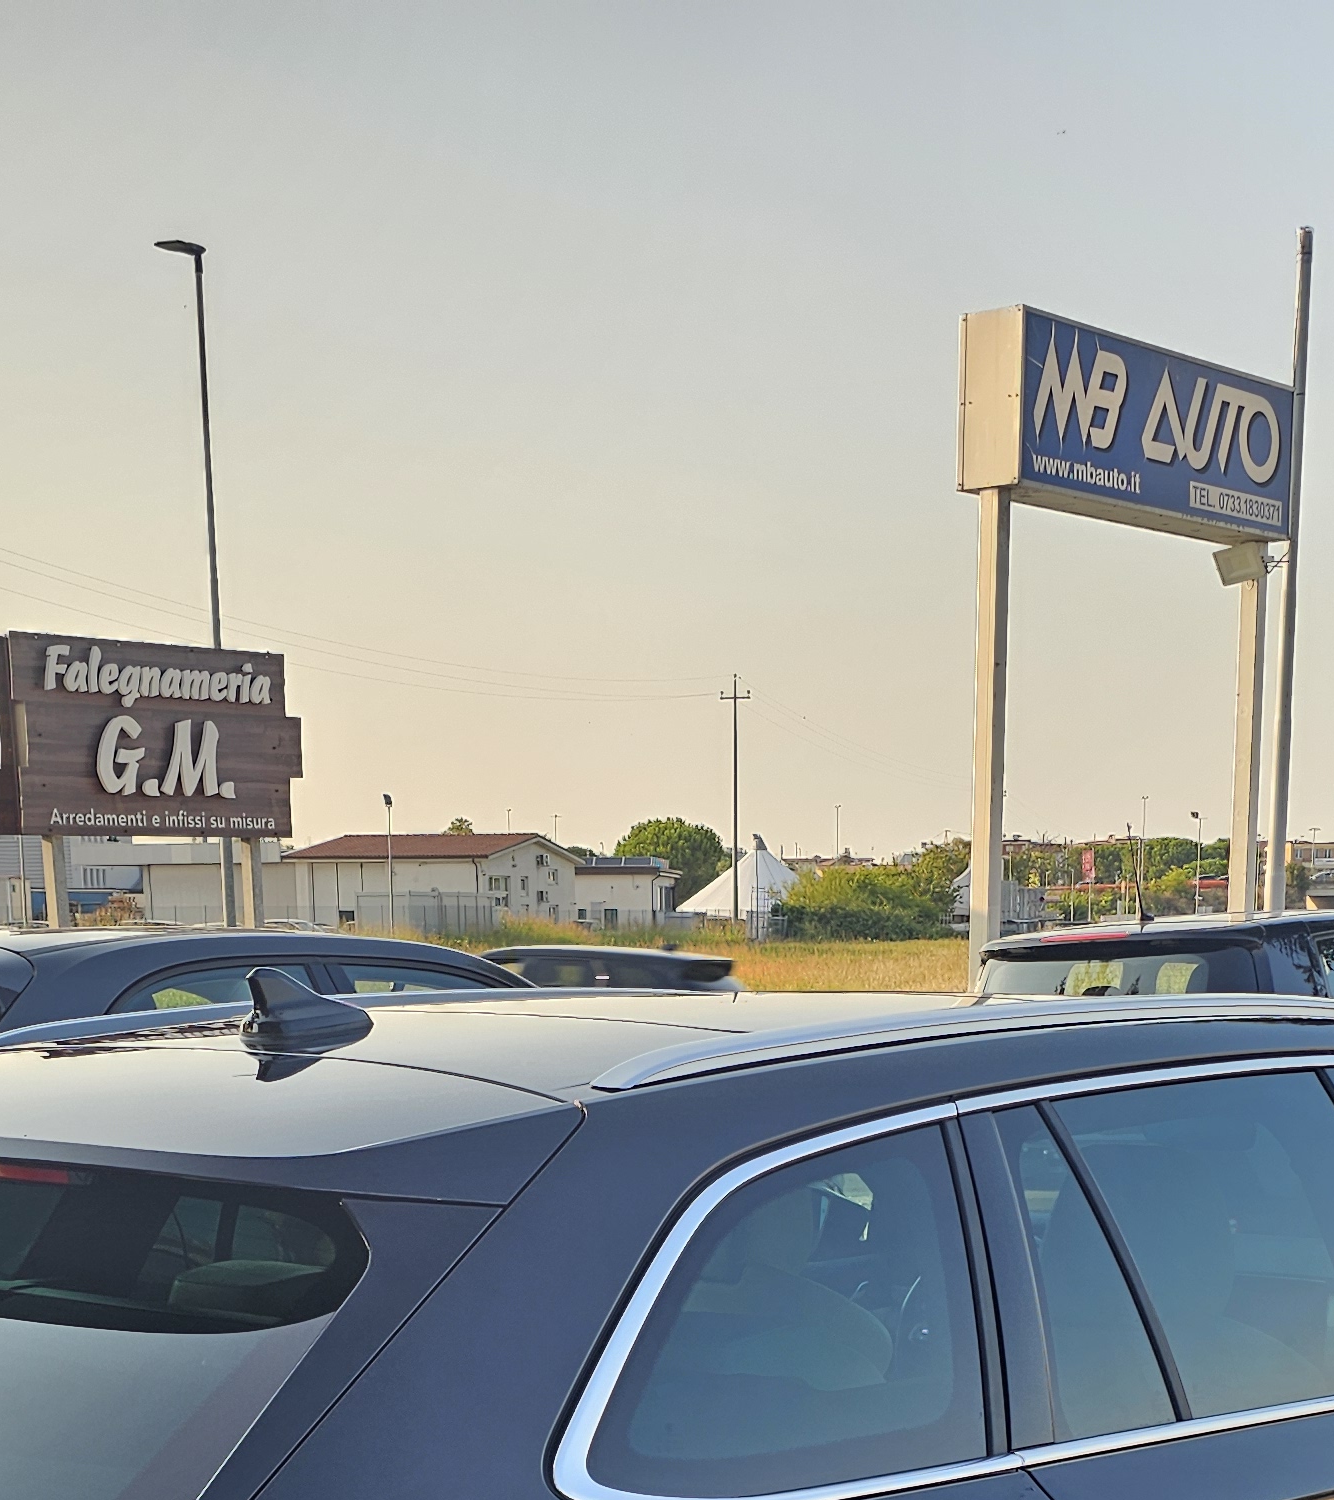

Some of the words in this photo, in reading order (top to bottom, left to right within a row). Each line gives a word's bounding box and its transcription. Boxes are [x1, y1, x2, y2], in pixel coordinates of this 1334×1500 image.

[1033, 322, 1129, 453] MB
[1141, 366, 1281, 485] AUTO
[1032, 453, 1141, 494] www.mbauto.it
[1191, 487, 1217, 509] TEL.
[1218, 493, 1281, 523] 0733.1830371
[44, 645, 272, 708] Falegnameria
[96, 715, 236, 799] G.M.
[50, 808, 147, 827] Arredamenti
[152, 817, 161, 827] e
[165, 810, 206, 829] infissi
[210, 817, 226, 829] su
[230, 814, 275, 830] misura
